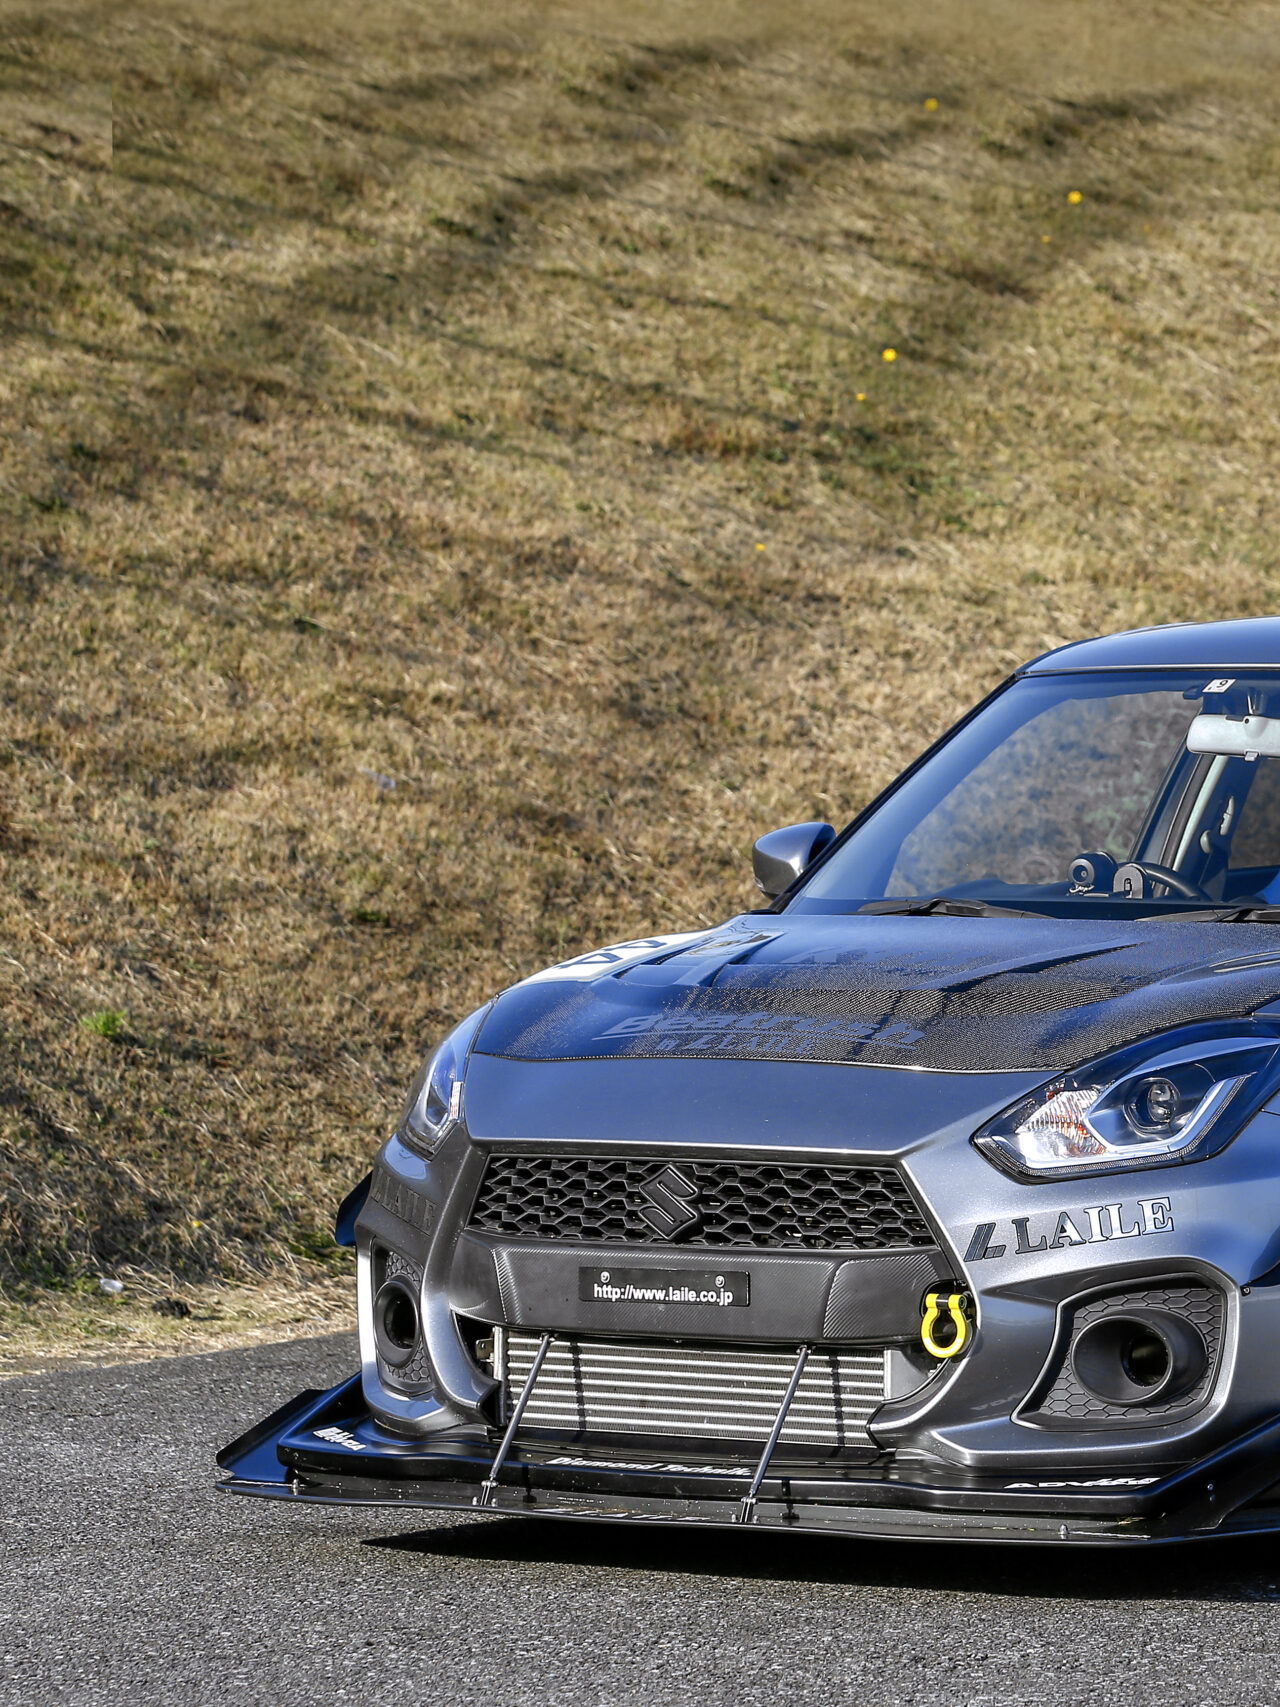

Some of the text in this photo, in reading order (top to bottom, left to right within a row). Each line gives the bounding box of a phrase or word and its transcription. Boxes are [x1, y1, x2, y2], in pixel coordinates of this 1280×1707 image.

[602, 1012, 926, 1044] Beatrush
[1012, 1196, 1175, 1254] LAILE
[593, 1283, 733, 1306] http://www.laile.co.jp
[546, 1456, 663, 1471] Diamond
